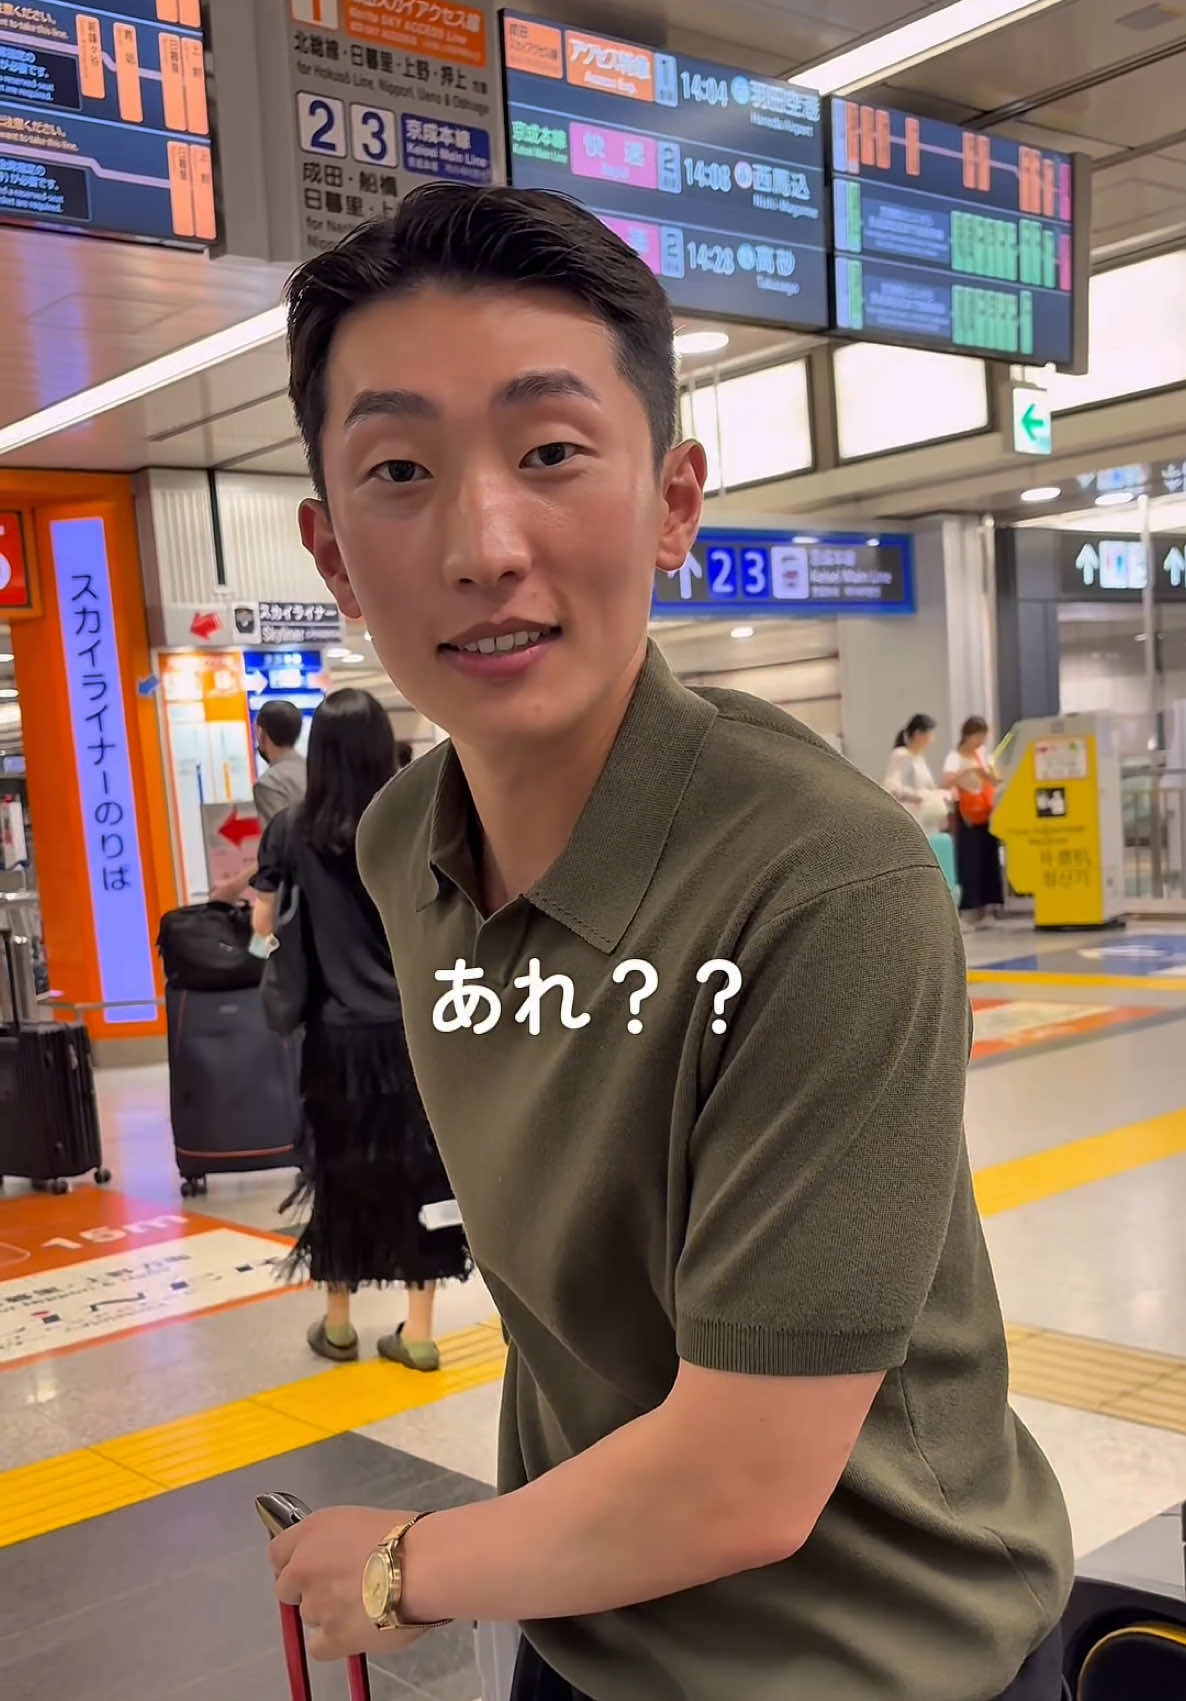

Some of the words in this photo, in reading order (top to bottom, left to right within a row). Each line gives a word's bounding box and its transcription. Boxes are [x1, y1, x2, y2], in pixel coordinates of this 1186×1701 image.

[680, 71, 728, 108] 14:04
[308, 99, 337, 152] 2
[361, 110, 388, 161] 3
[710, 551, 734, 593] 2
[744, 551, 766, 594] 3
[260, 603, 338, 621] スカイライナー
[71, 574, 132, 891] スカイライナーのりば
